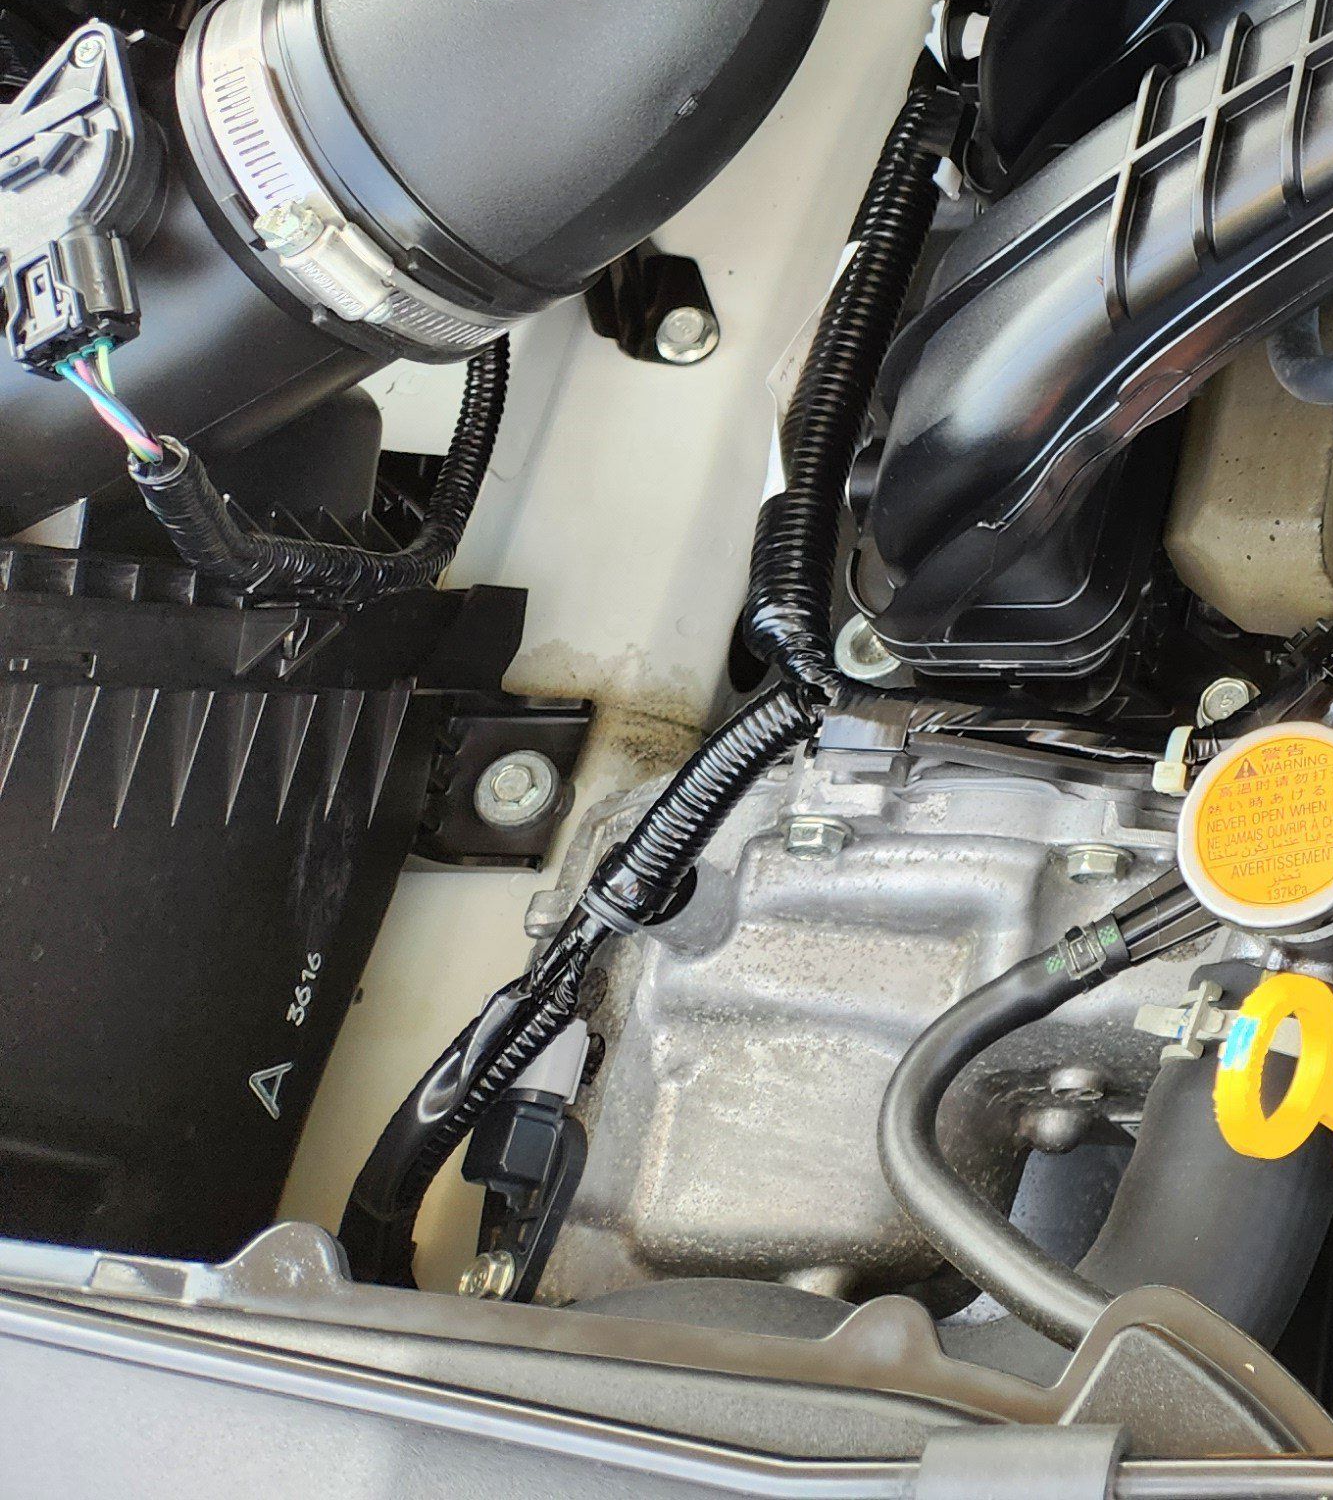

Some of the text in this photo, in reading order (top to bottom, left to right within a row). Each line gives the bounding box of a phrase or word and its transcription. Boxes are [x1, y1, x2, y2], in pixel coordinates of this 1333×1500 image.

[1262, 754, 1328, 775] WARNING
[1206, 816, 1246, 834] NEVER
[1252, 808, 1285, 825] OPEN
[1289, 800, 1327, 817] WHEN
[1207, 837, 1221, 850] NE
[1225, 829, 1263, 847] JAMAIS
[1267, 821, 1307, 839] OUVRIR
[1267, 885, 1308, 901] 137kPa
[286, 952, 322, 1027] 3616
